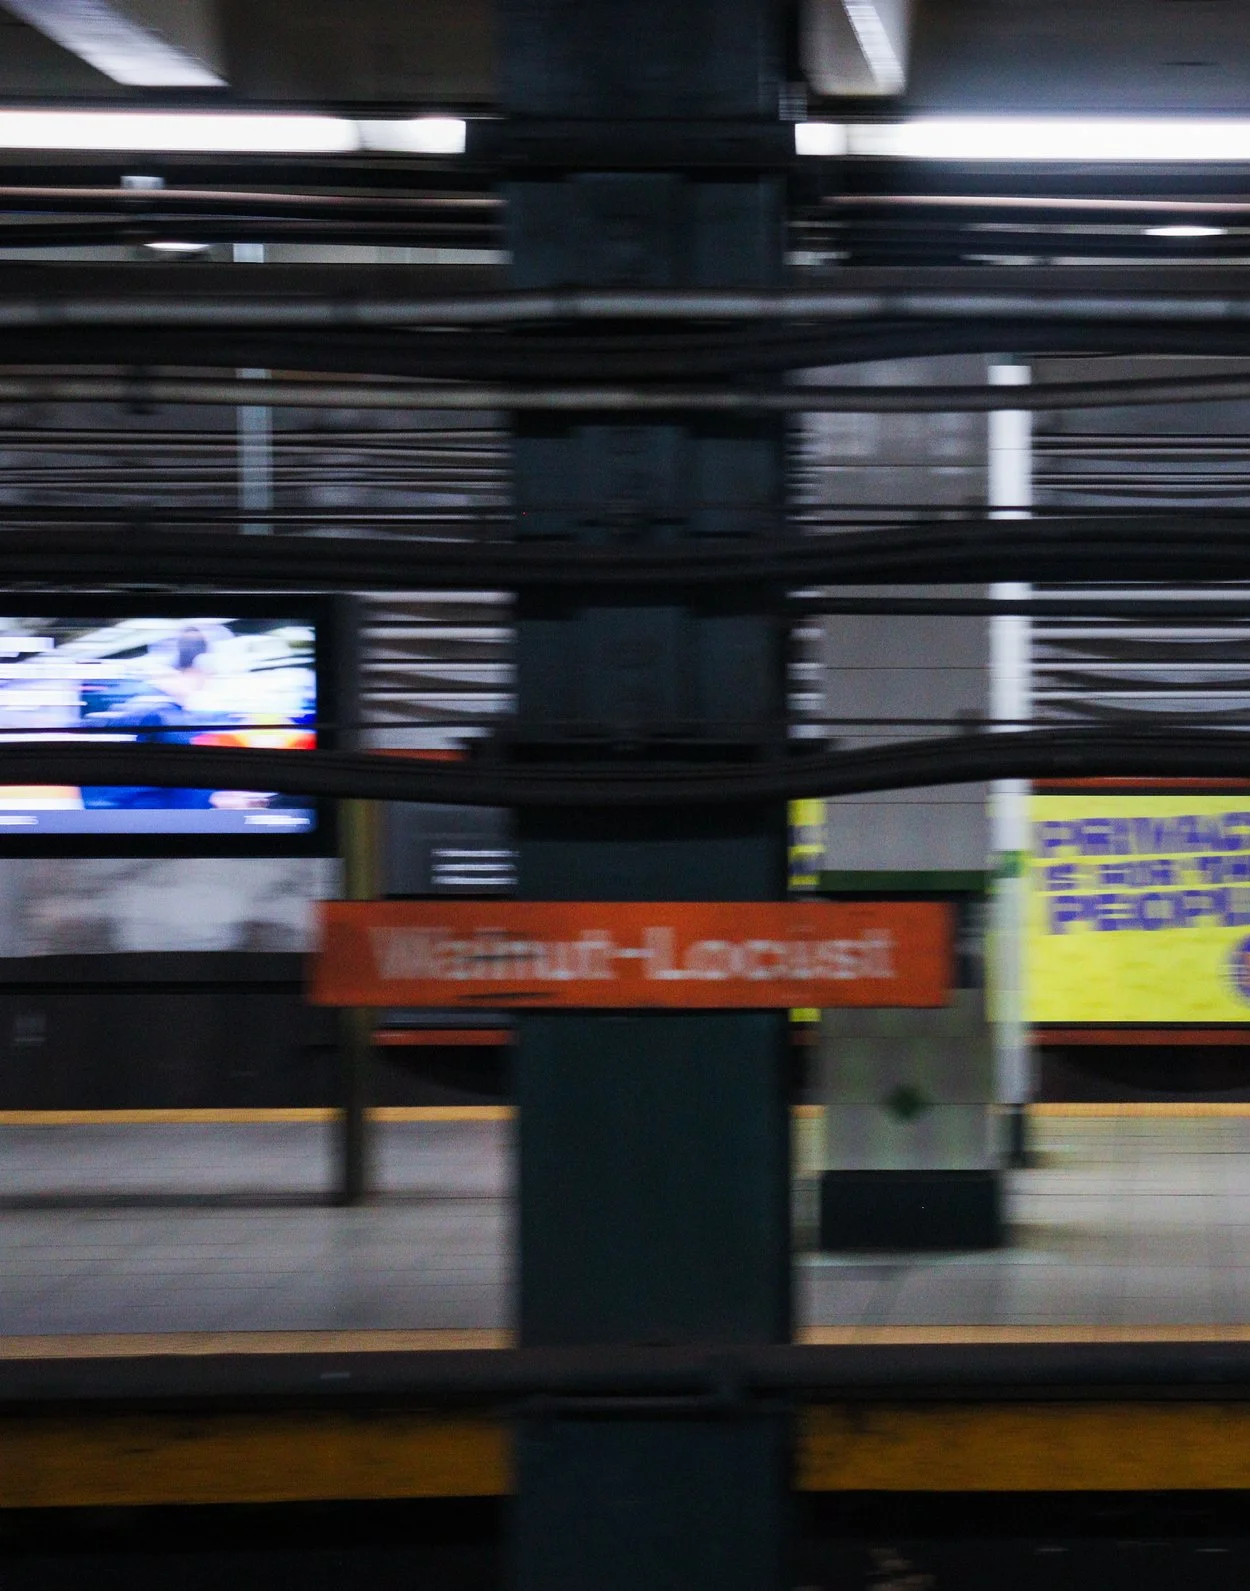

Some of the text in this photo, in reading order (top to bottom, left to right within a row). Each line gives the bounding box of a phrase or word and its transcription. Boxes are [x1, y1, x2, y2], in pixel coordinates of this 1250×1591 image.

[1037, 863, 1092, 891] IS
[1098, 858, 1176, 889] FOR
[370, 926, 895, 980] Walnut-Locust
